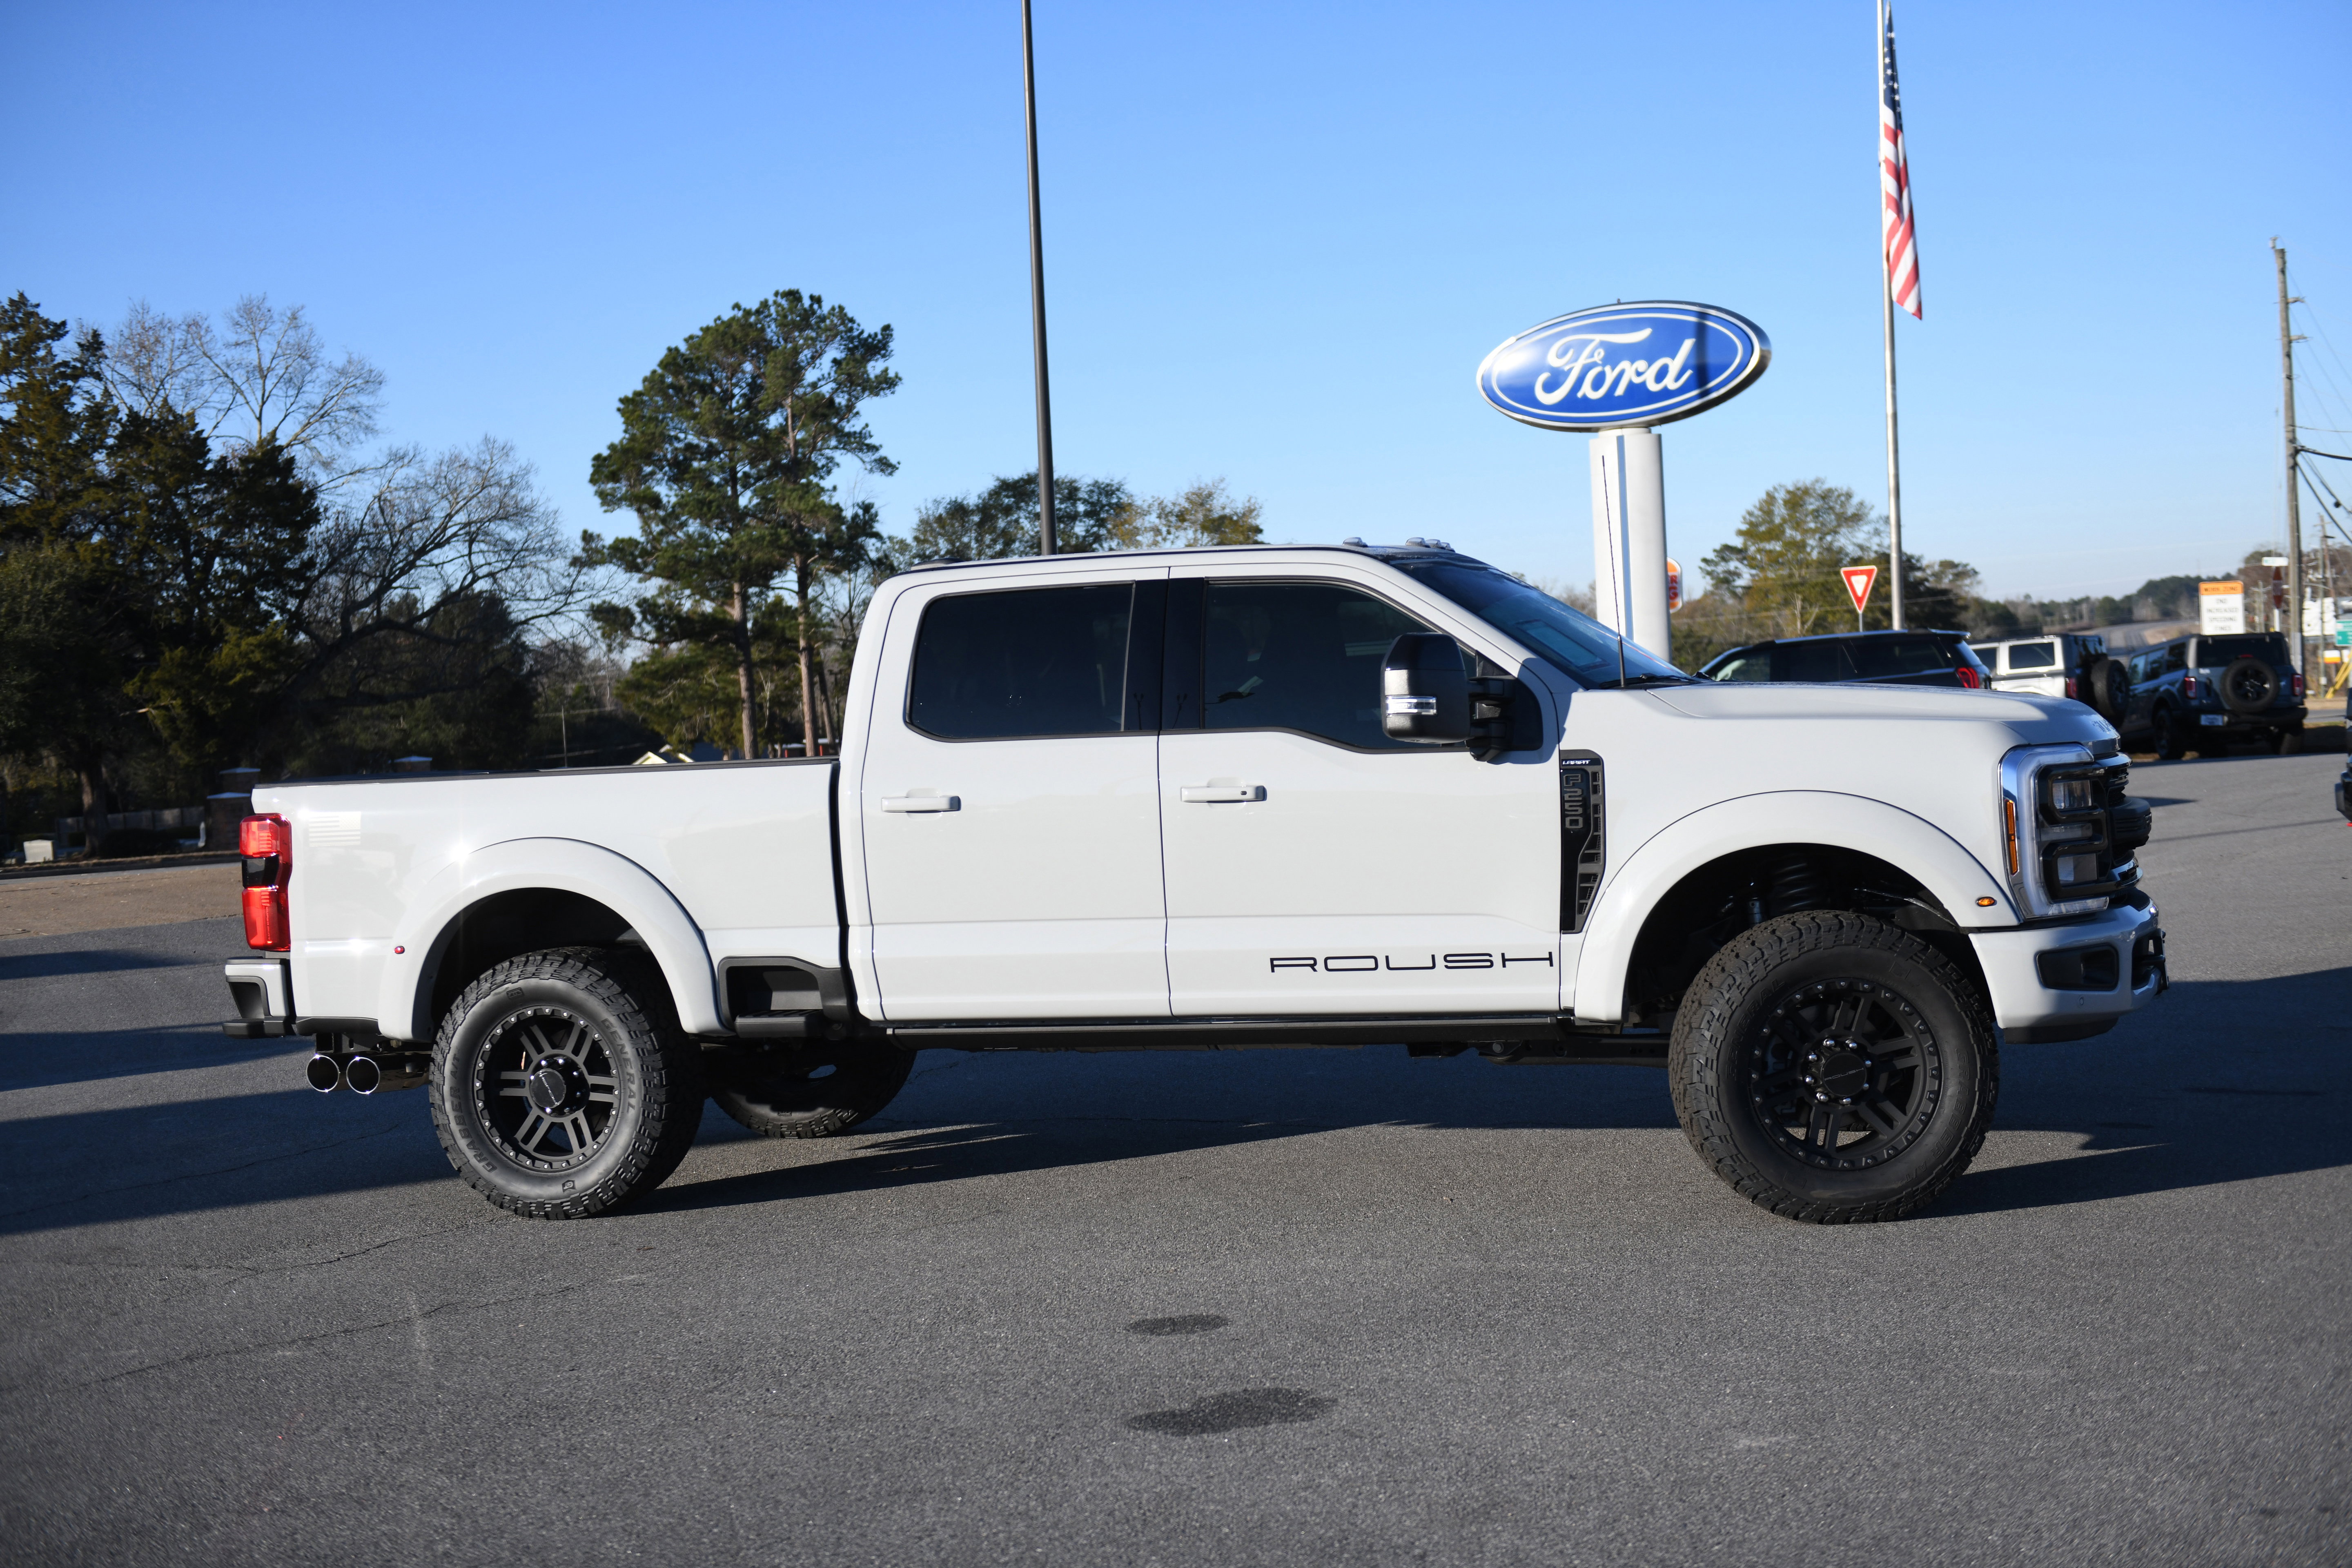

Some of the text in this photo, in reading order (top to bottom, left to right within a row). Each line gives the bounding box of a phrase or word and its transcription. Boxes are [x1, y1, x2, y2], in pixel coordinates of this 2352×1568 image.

[1535, 328, 1696, 405] Ford
[1564, 774, 1583, 829] F250
[1270, 951, 1554, 973] ROUSH
[601, 1018, 636, 1114] GENERAL
[1726, 979, 1785, 1081] GENERAL
[1824, 1067, 1864, 1081] ROUSH
[1930, 1048, 1970, 1159] GRABBER
[450, 1086, 498, 1174] GRABBER
